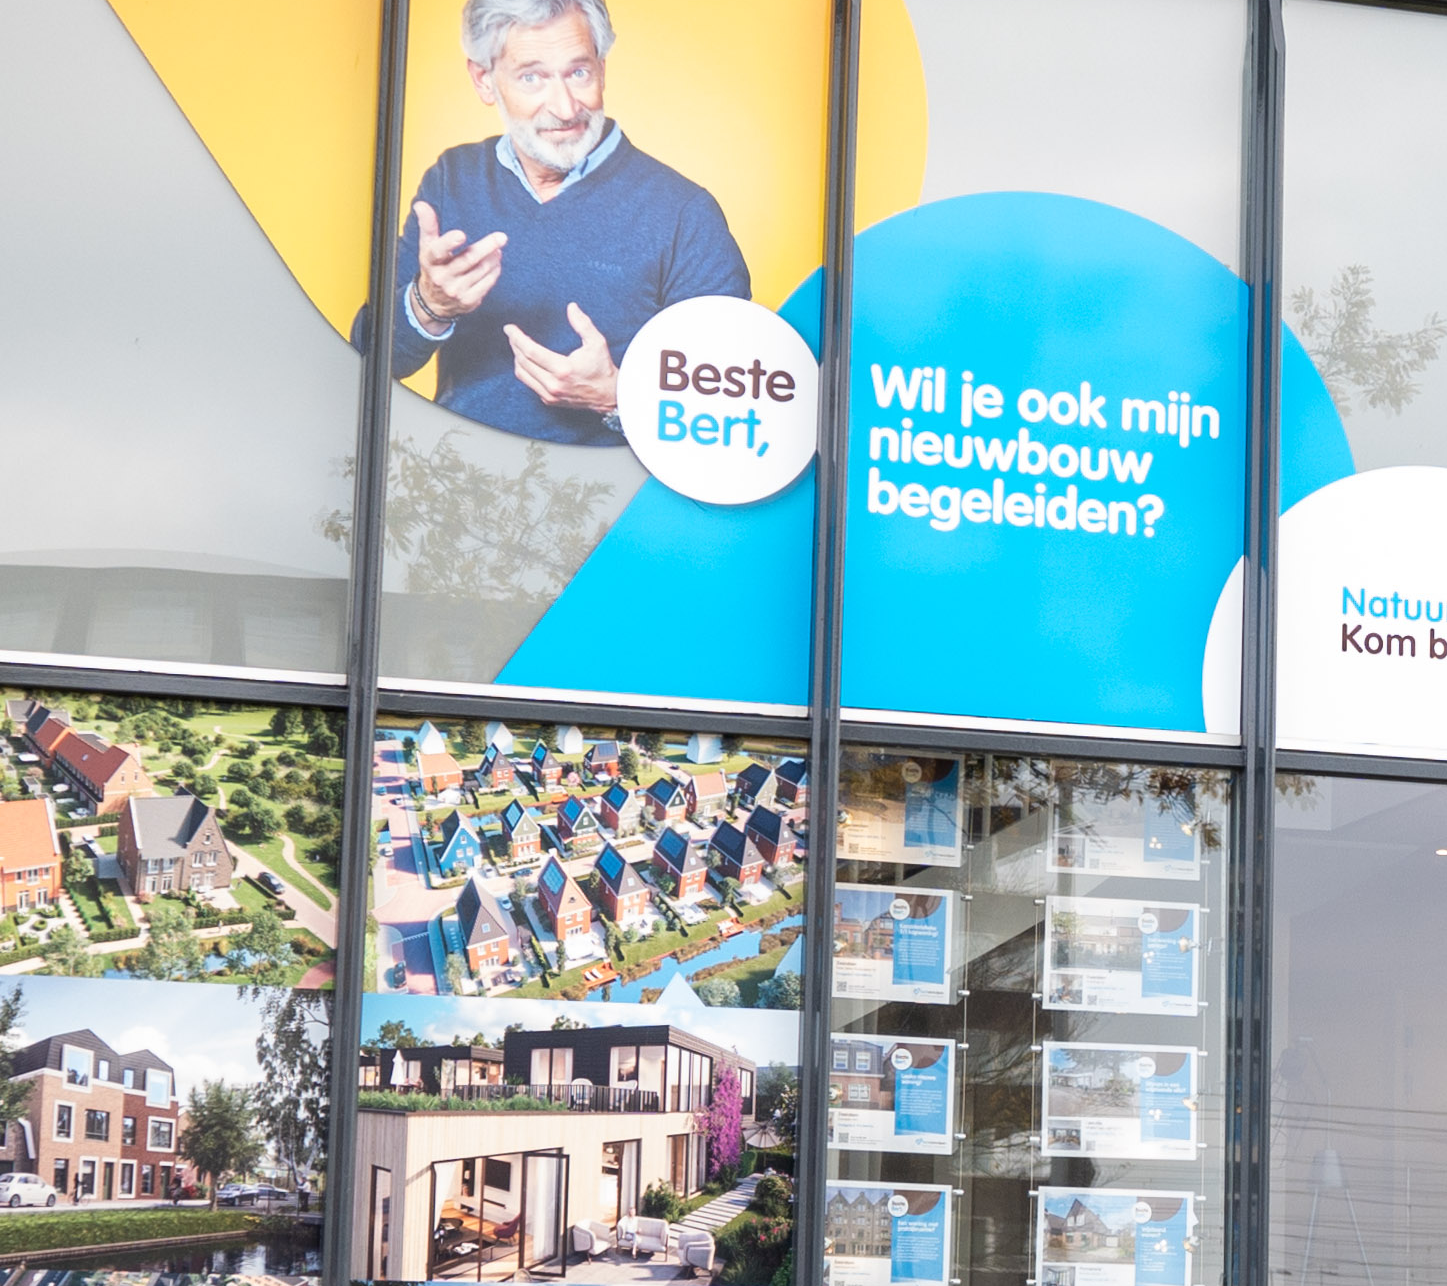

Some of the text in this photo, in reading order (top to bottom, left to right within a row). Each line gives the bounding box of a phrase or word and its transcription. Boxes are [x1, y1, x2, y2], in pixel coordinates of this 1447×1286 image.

[658, 348, 796, 403] Beste
[656, 403, 770, 459] Bert,
[870, 364, 1220, 448] Wil je ook mijn
[868, 419, 1154, 484] nieuwbouw
[866, 468, 1166, 538] begeleiden?
[1340, 623, 1416, 657] Kom
